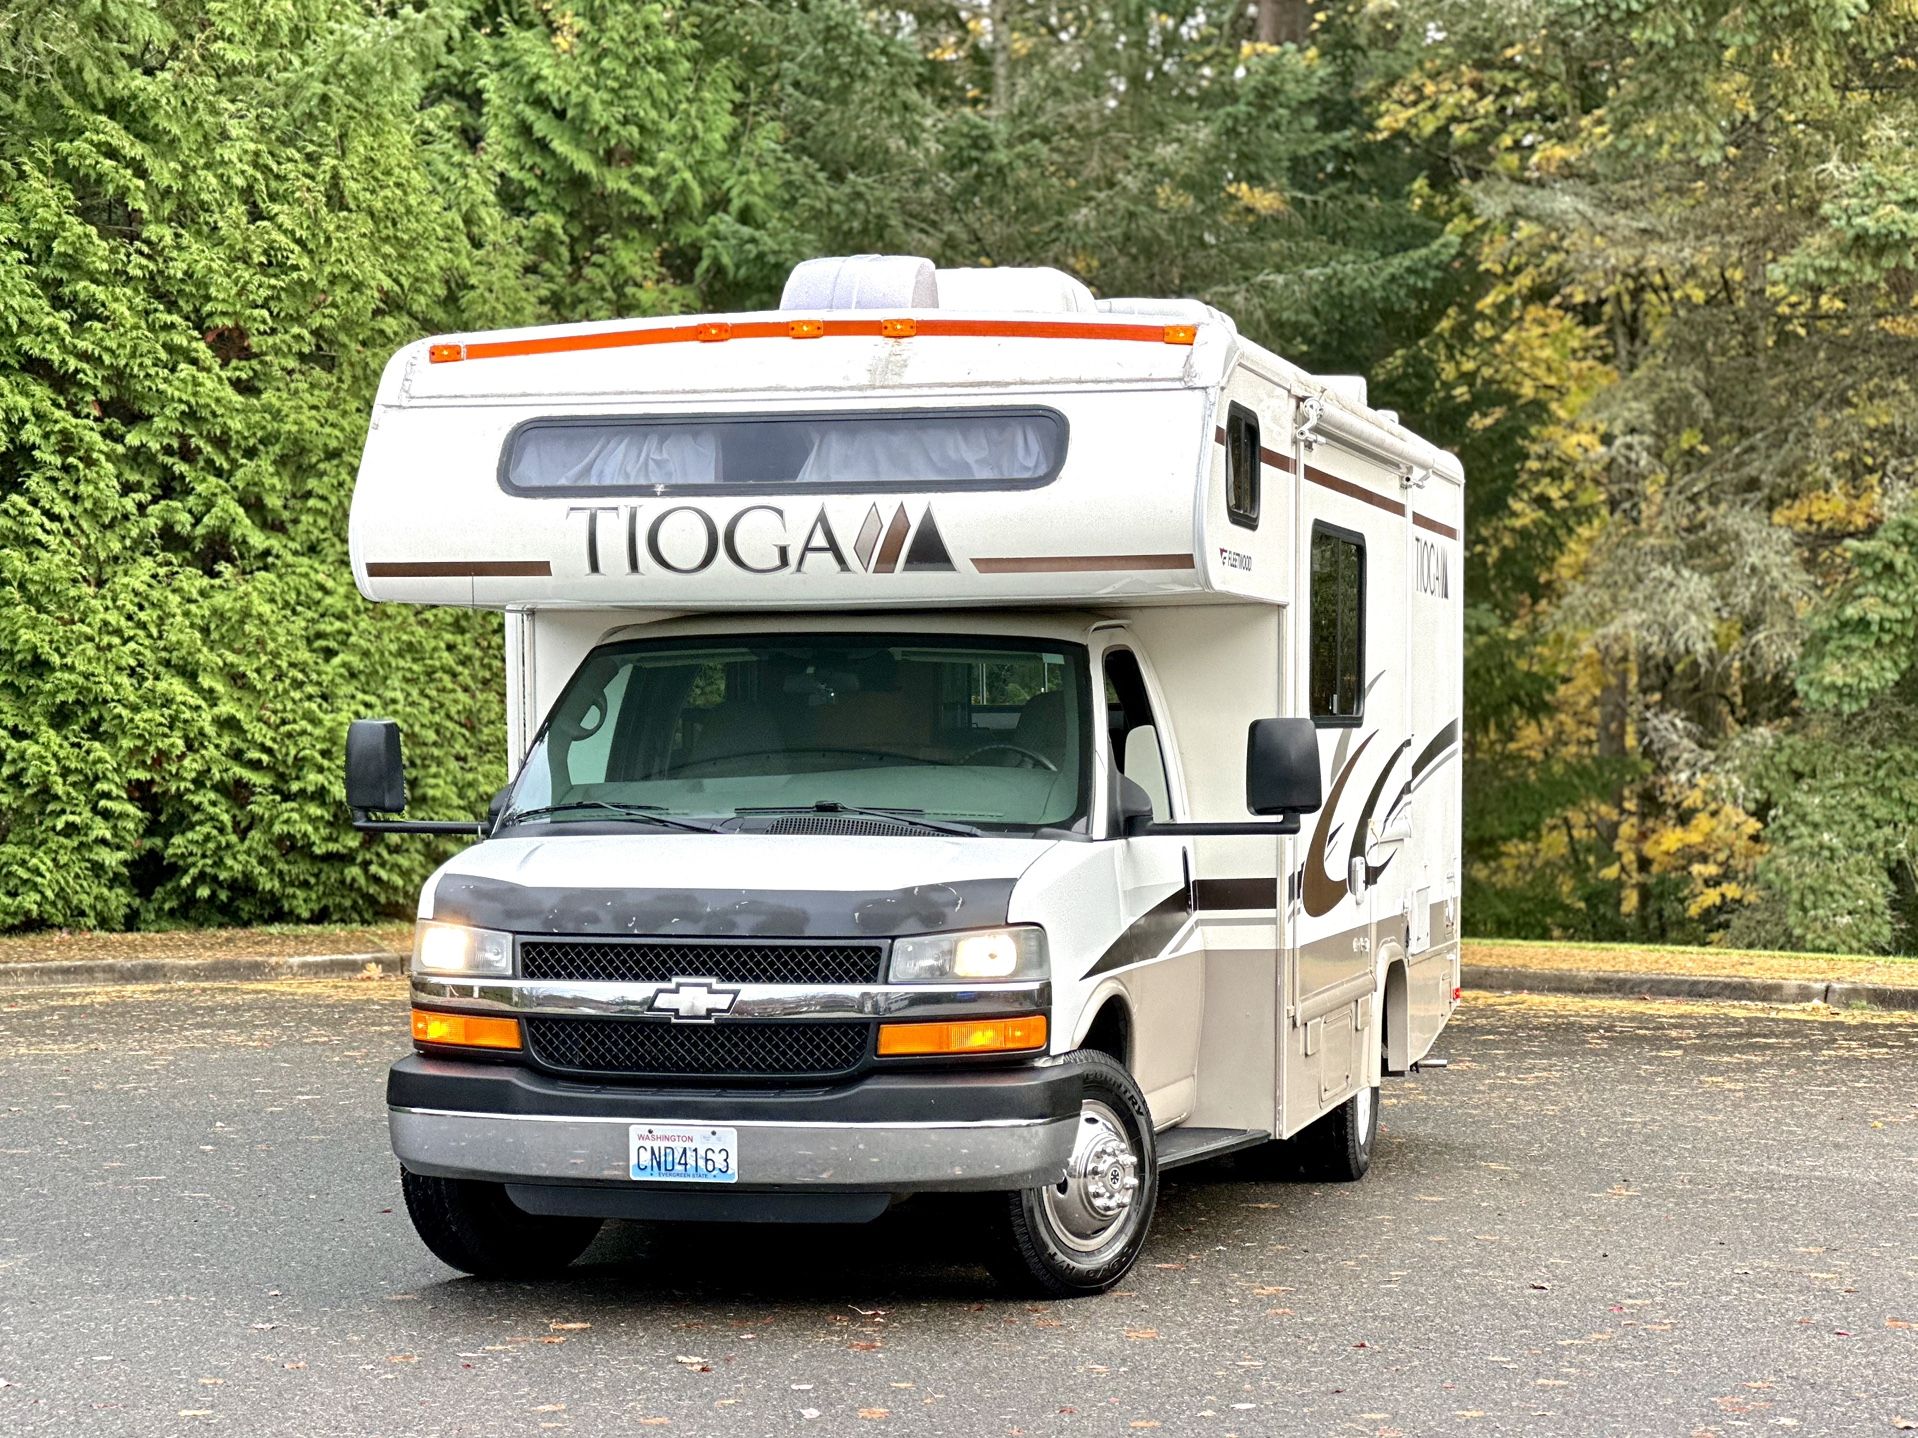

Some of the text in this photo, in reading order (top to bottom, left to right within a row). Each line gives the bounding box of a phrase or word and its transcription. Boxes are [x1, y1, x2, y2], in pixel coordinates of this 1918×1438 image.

[566, 502, 857, 576] TIOGA
[1227, 550, 1252, 572] FLEETWOOD
[1415, 536, 1440, 597] TIOGA
[637, 1134, 694, 1143] WASHINGTON
[637, 1145, 729, 1173] CND4163
